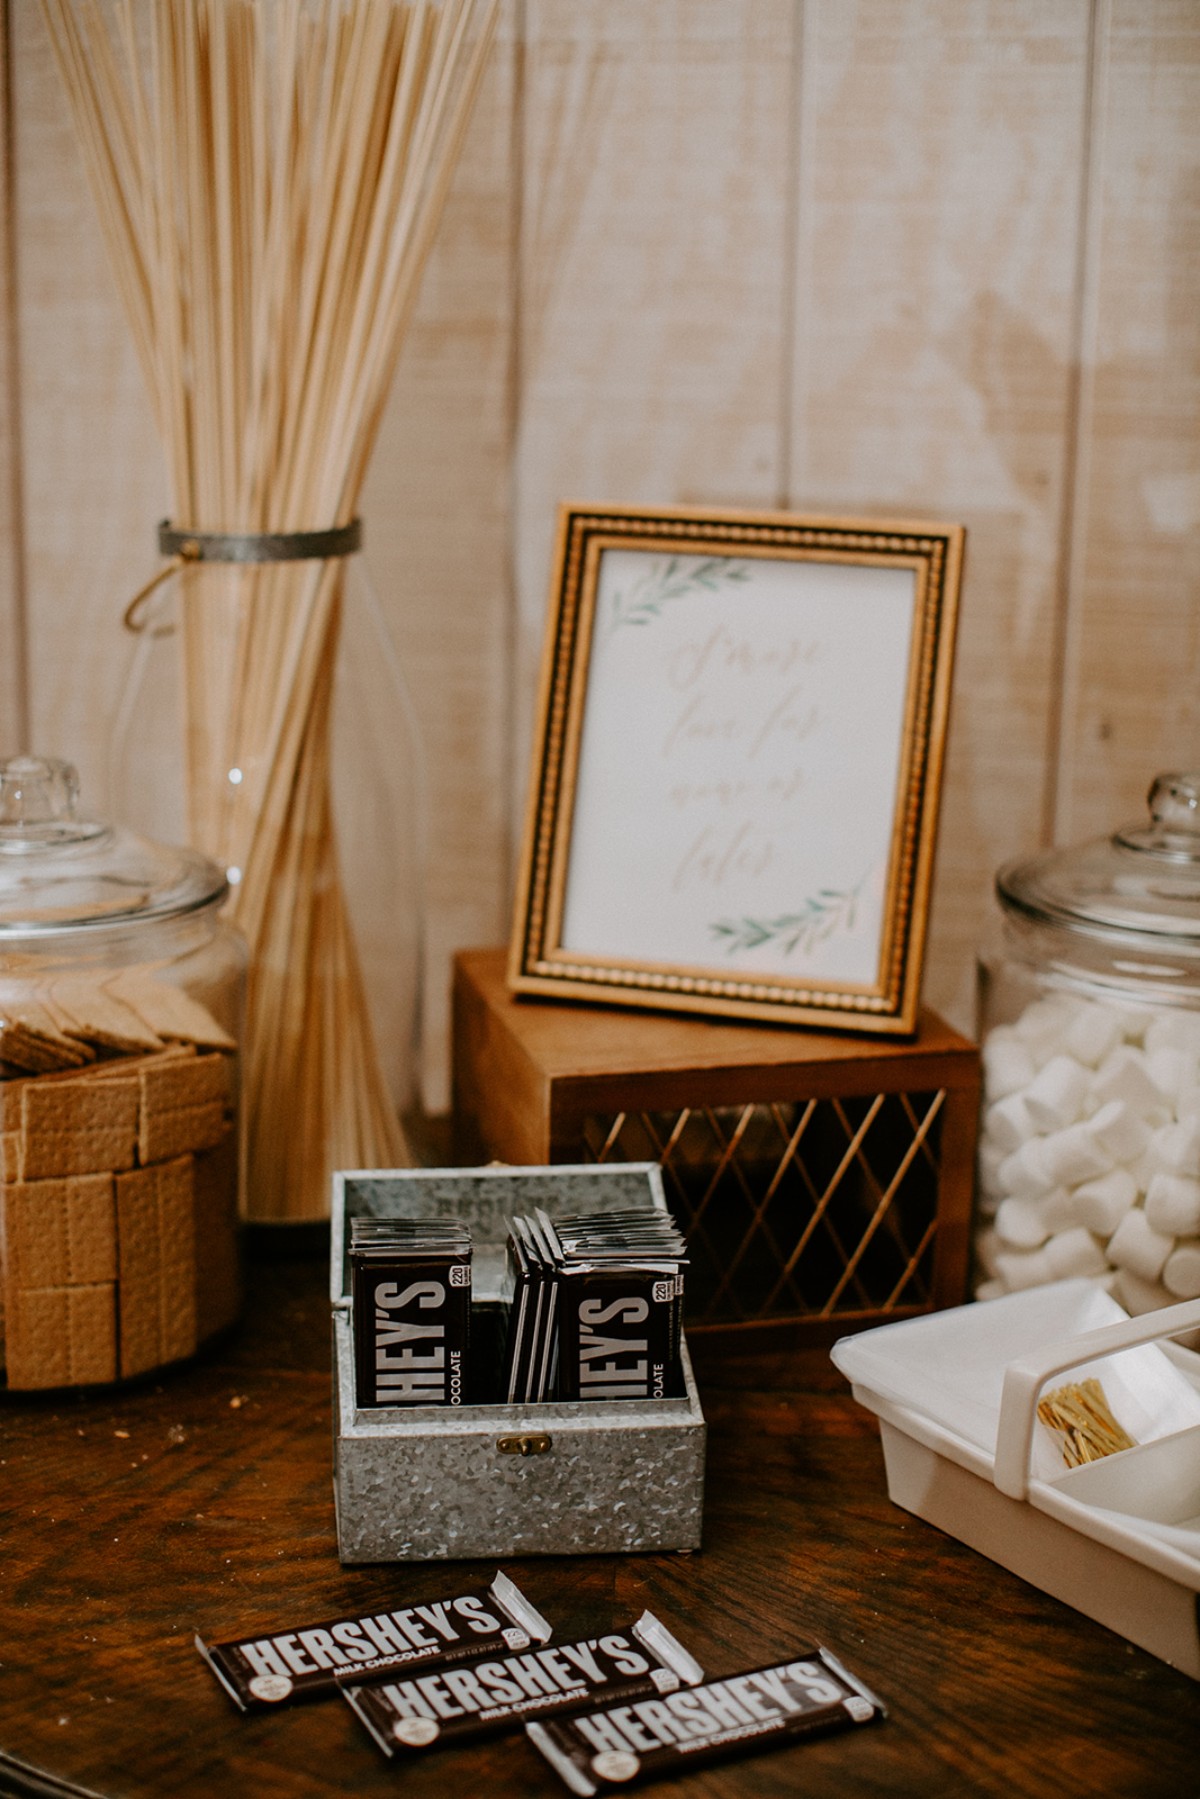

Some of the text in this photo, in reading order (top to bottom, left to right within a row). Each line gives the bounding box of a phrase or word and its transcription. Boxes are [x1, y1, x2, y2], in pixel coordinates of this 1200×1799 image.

[452, 1267, 463, 1285] 220
[656, 1284, 666, 1300] 220
[374, 1281, 446, 1406] HEY'S
[240, 1596, 500, 1677] HERSHEY'S
[333, 1661, 366, 1678] MILK
[366, 1645, 441, 1669] CHOCOLATE
[383, 1635, 649, 1721] HERSHEY'S
[479, 1704, 513, 1721] MILK
[513, 1688, 589, 1713] CHOCOLATE
[575, 1661, 842, 1752] HERSHEY'S
[711, 1717, 785, 1745] CHOCOLATE
